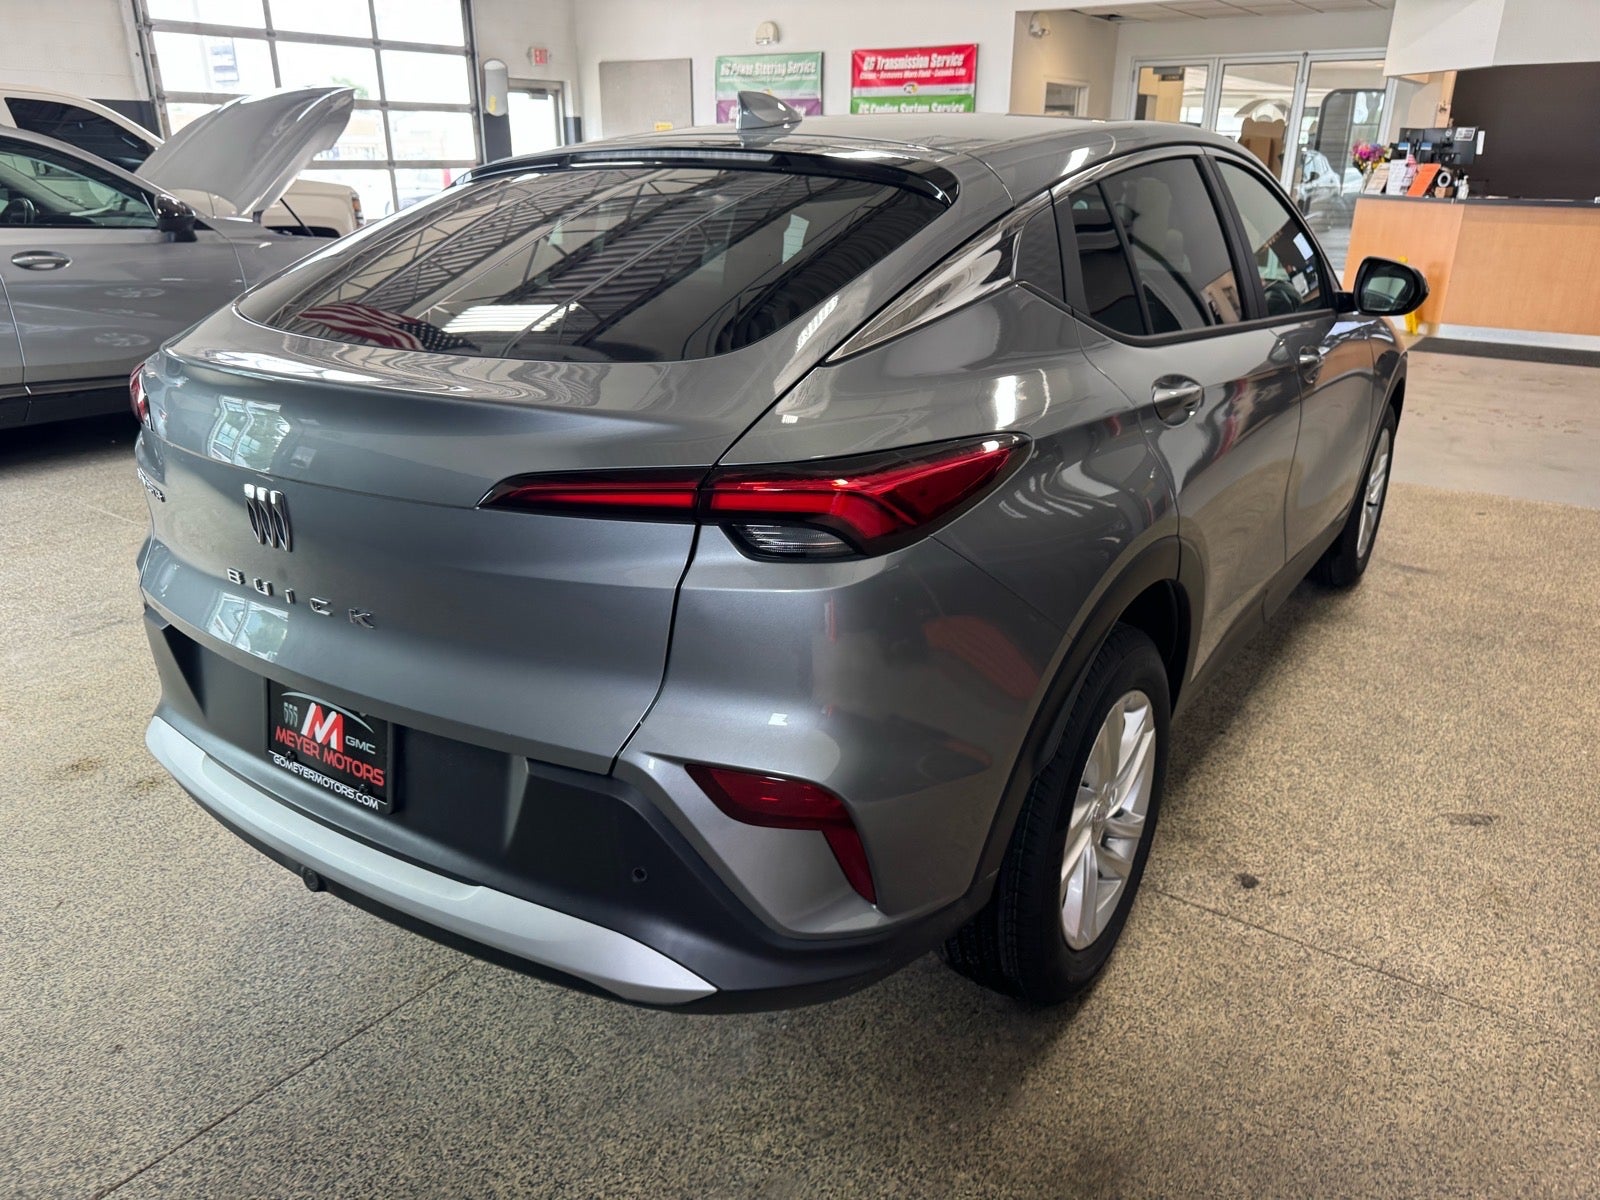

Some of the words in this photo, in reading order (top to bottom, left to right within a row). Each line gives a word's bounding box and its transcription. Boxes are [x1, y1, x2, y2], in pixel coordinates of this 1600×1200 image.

[787, 60, 817, 74] Service
[876, 55, 930, 70] Transmission
[930, 52, 965, 67] Service
[931, 102, 966, 112] Service
[227, 567, 377, 629] BUICK
[345, 735, 376, 755] GMC
[275, 725, 320, 760] MEYER
[323, 747, 385, 787] MOTORS
[273, 754, 379, 811] GOMEYERMOTORS.COM
